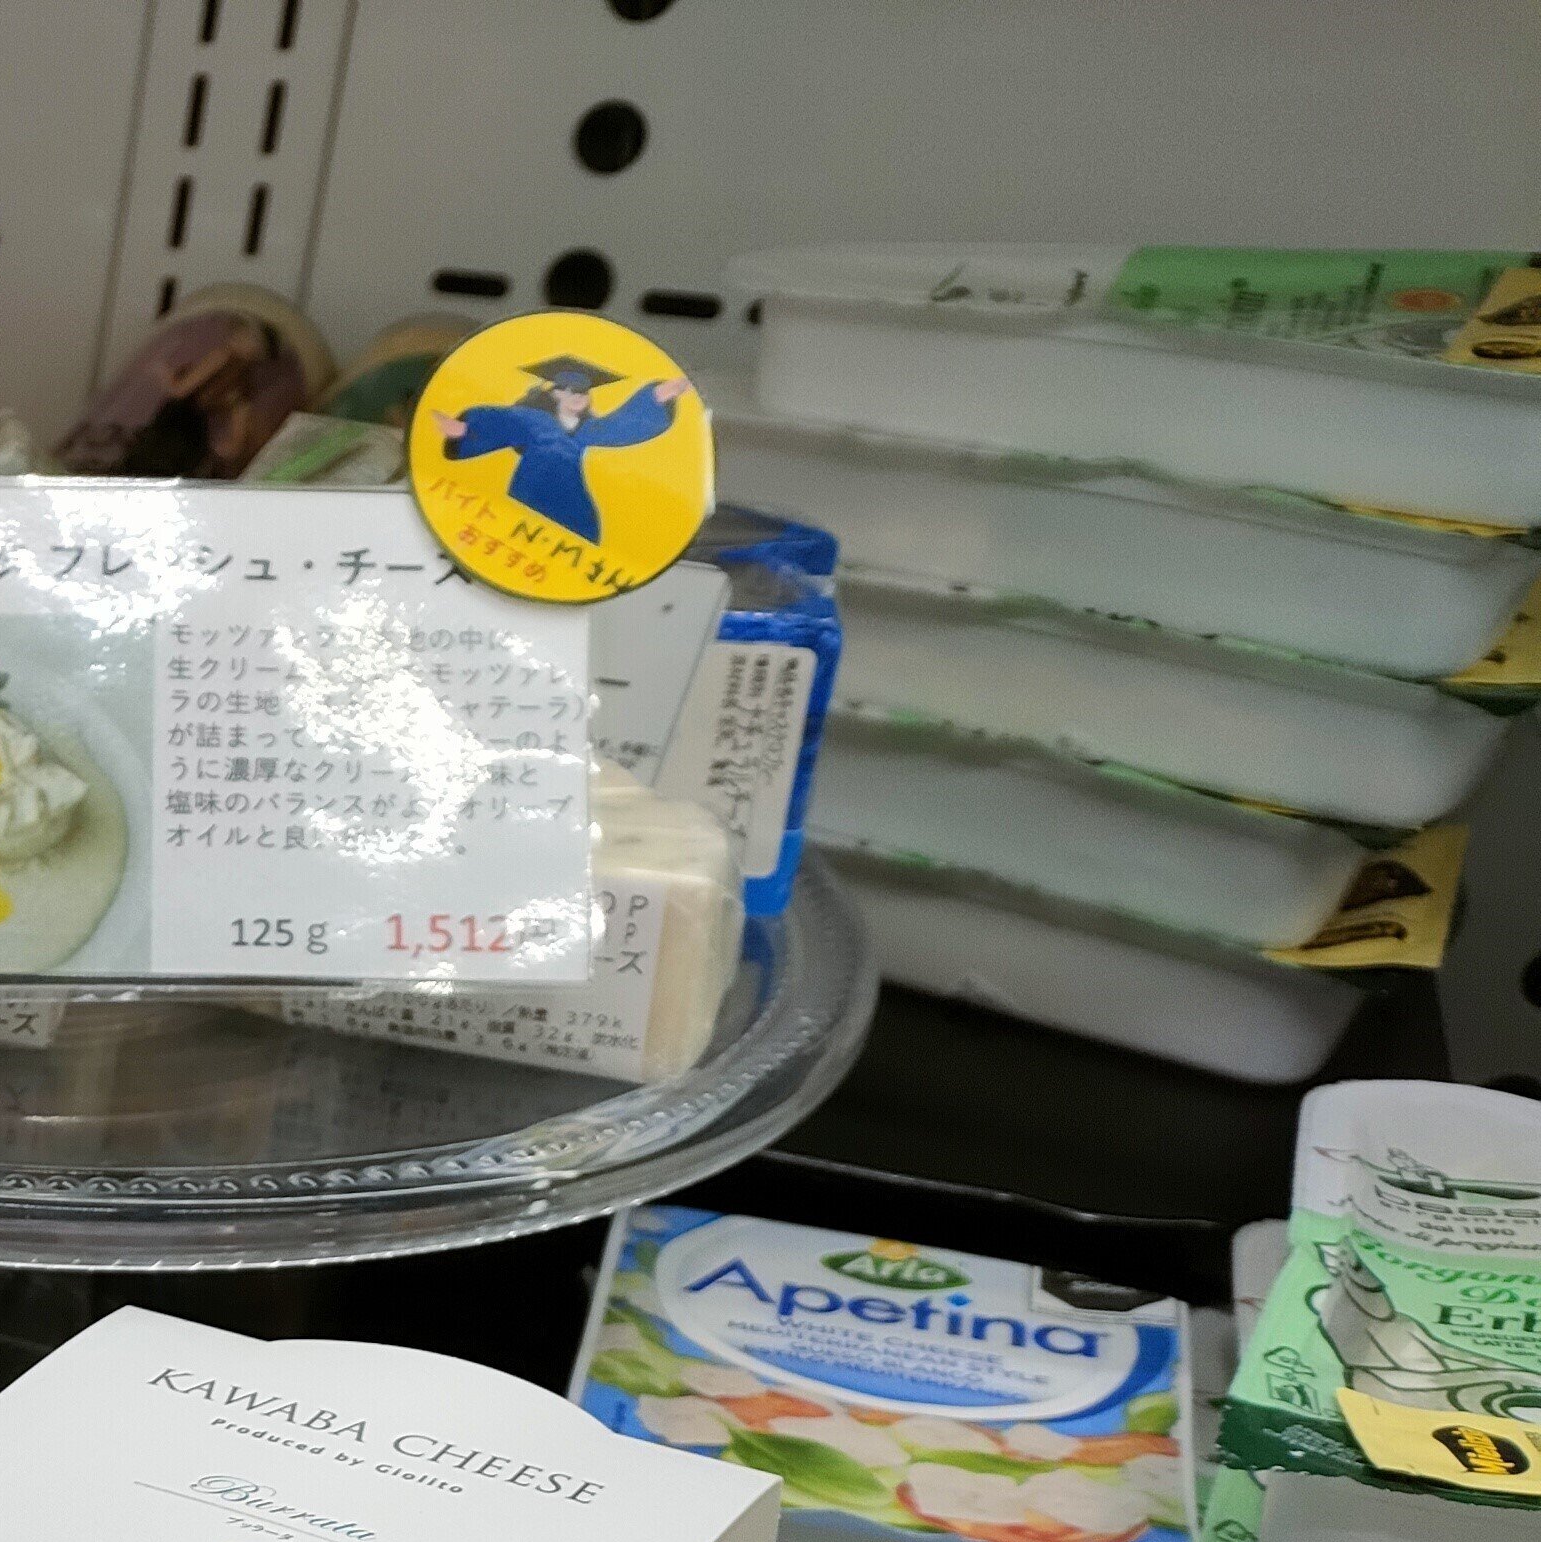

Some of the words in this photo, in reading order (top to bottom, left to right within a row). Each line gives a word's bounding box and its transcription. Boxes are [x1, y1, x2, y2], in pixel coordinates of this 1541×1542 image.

[429, 476, 498, 522] バイト
[458, 522, 548, 584] おすすめ
[231, 917, 295, 947] 125
[306, 920, 329, 955] g
[842, 1256, 948, 1283] Arla
[684, 1256, 1105, 1359] Apetina
[147, 1367, 367, 1444] KAWABA
[392, 1433, 606, 1506] CHEESE
[211, 1417, 327, 1456] Produced
[333, 1451, 364, 1467] by
[374, 1464, 464, 1495] Giolito
[189, 1474, 377, 1542] Burrata
